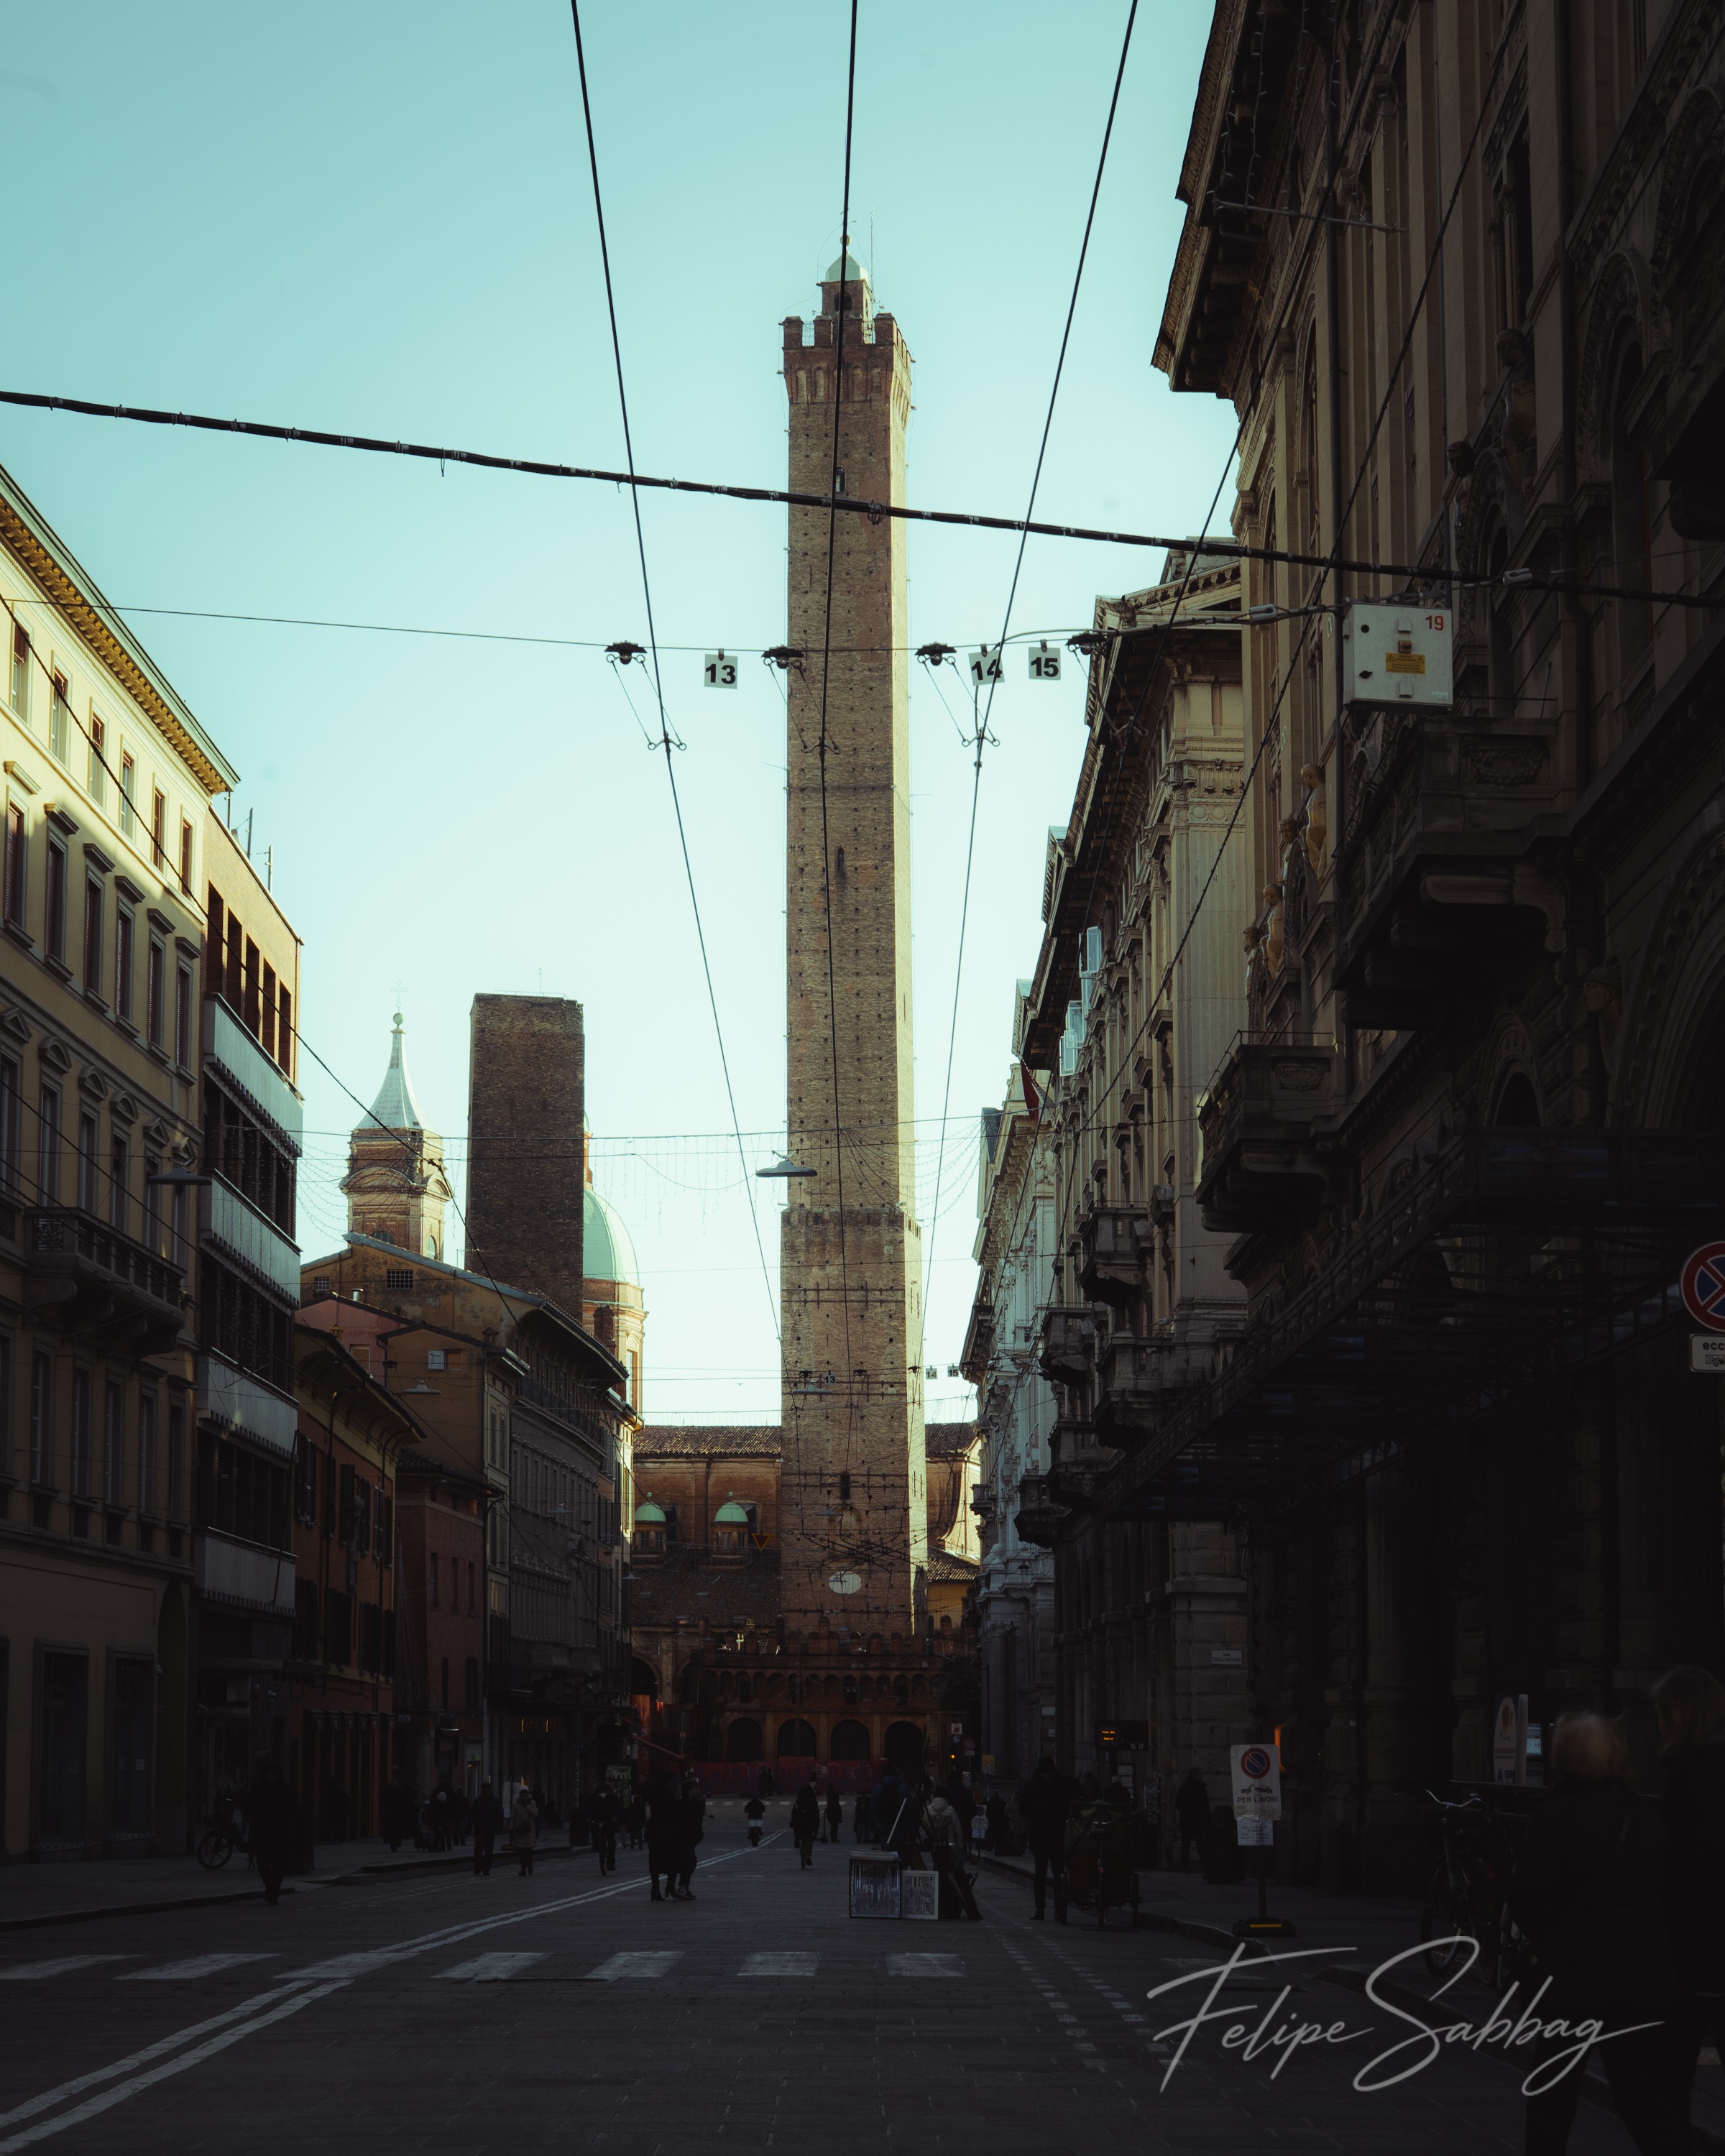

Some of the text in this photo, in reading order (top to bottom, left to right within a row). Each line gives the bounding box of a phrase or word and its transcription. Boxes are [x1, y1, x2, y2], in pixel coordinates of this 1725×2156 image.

[1425, 615, 1444, 631] 19
[705, 664, 736, 685] 13
[971, 658, 1003, 681] 14
[1030, 657, 1059, 678] 15
